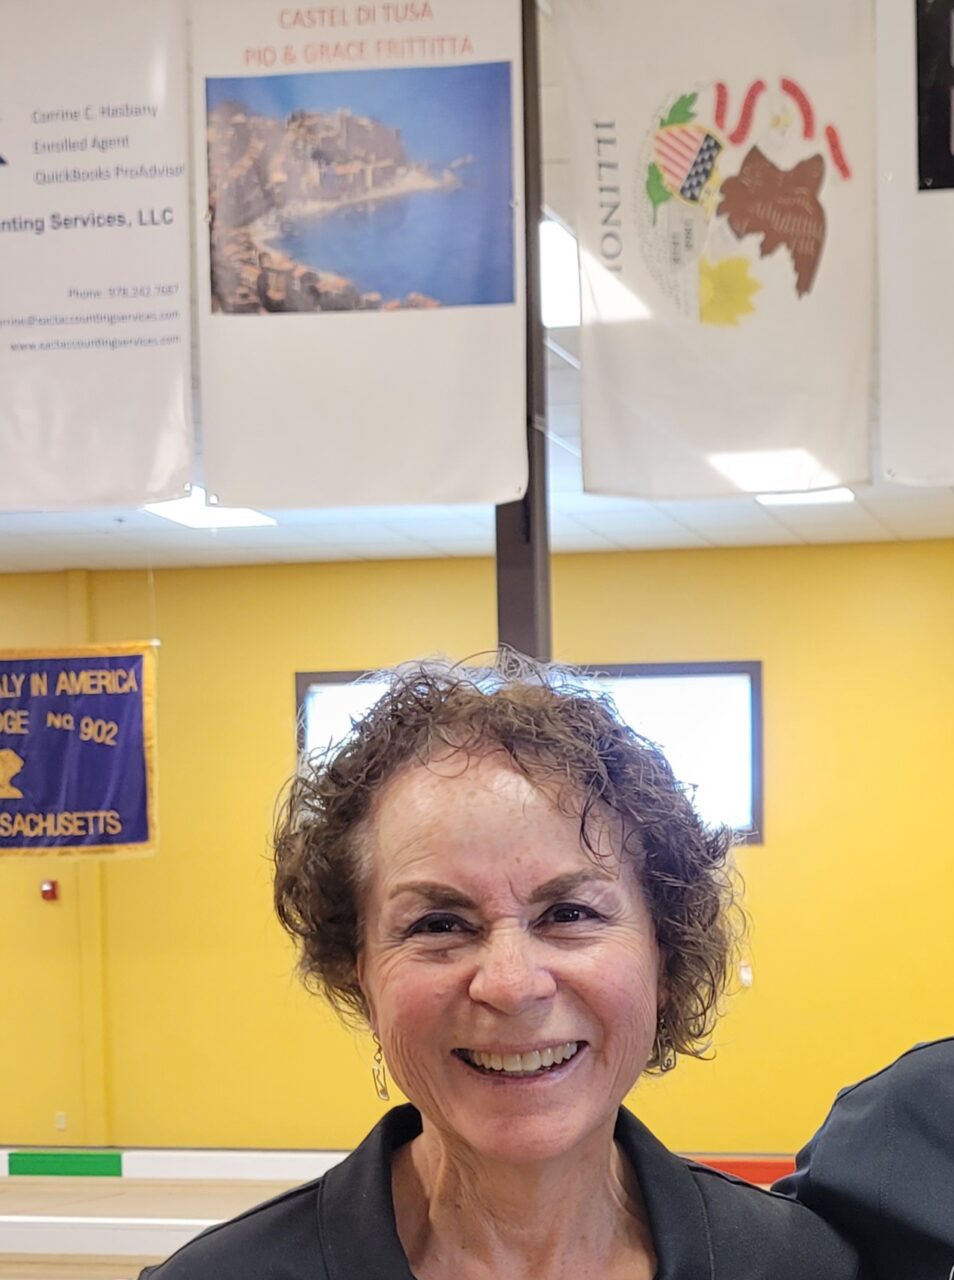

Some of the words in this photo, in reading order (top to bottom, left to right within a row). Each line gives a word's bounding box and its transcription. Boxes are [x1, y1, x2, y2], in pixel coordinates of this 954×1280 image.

[278, 8, 349, 30] CASTEL
[357, 5, 376, 25] DI
[383, 1, 433, 23] TUSA
[282, 45, 297, 64] &
[304, 40, 365, 63] GRACE
[33, 137, 87, 154] Enrolled
[91, 135, 130, 152] Agent
[34, 167, 111, 185] QuickBooks
[0, 215, 45, 235] nting
[50, 211, 132, 230] Services,
[138, 207, 174, 226] LLC
[0, 673, 25, 698] LY
[30, 671, 47, 697] IN
[55, 668, 138, 696] AMERICA
[0, 709, 29, 734] GE
[80, 716, 118, 746] 902
[0, 810, 122, 837] SACHUSETTS
